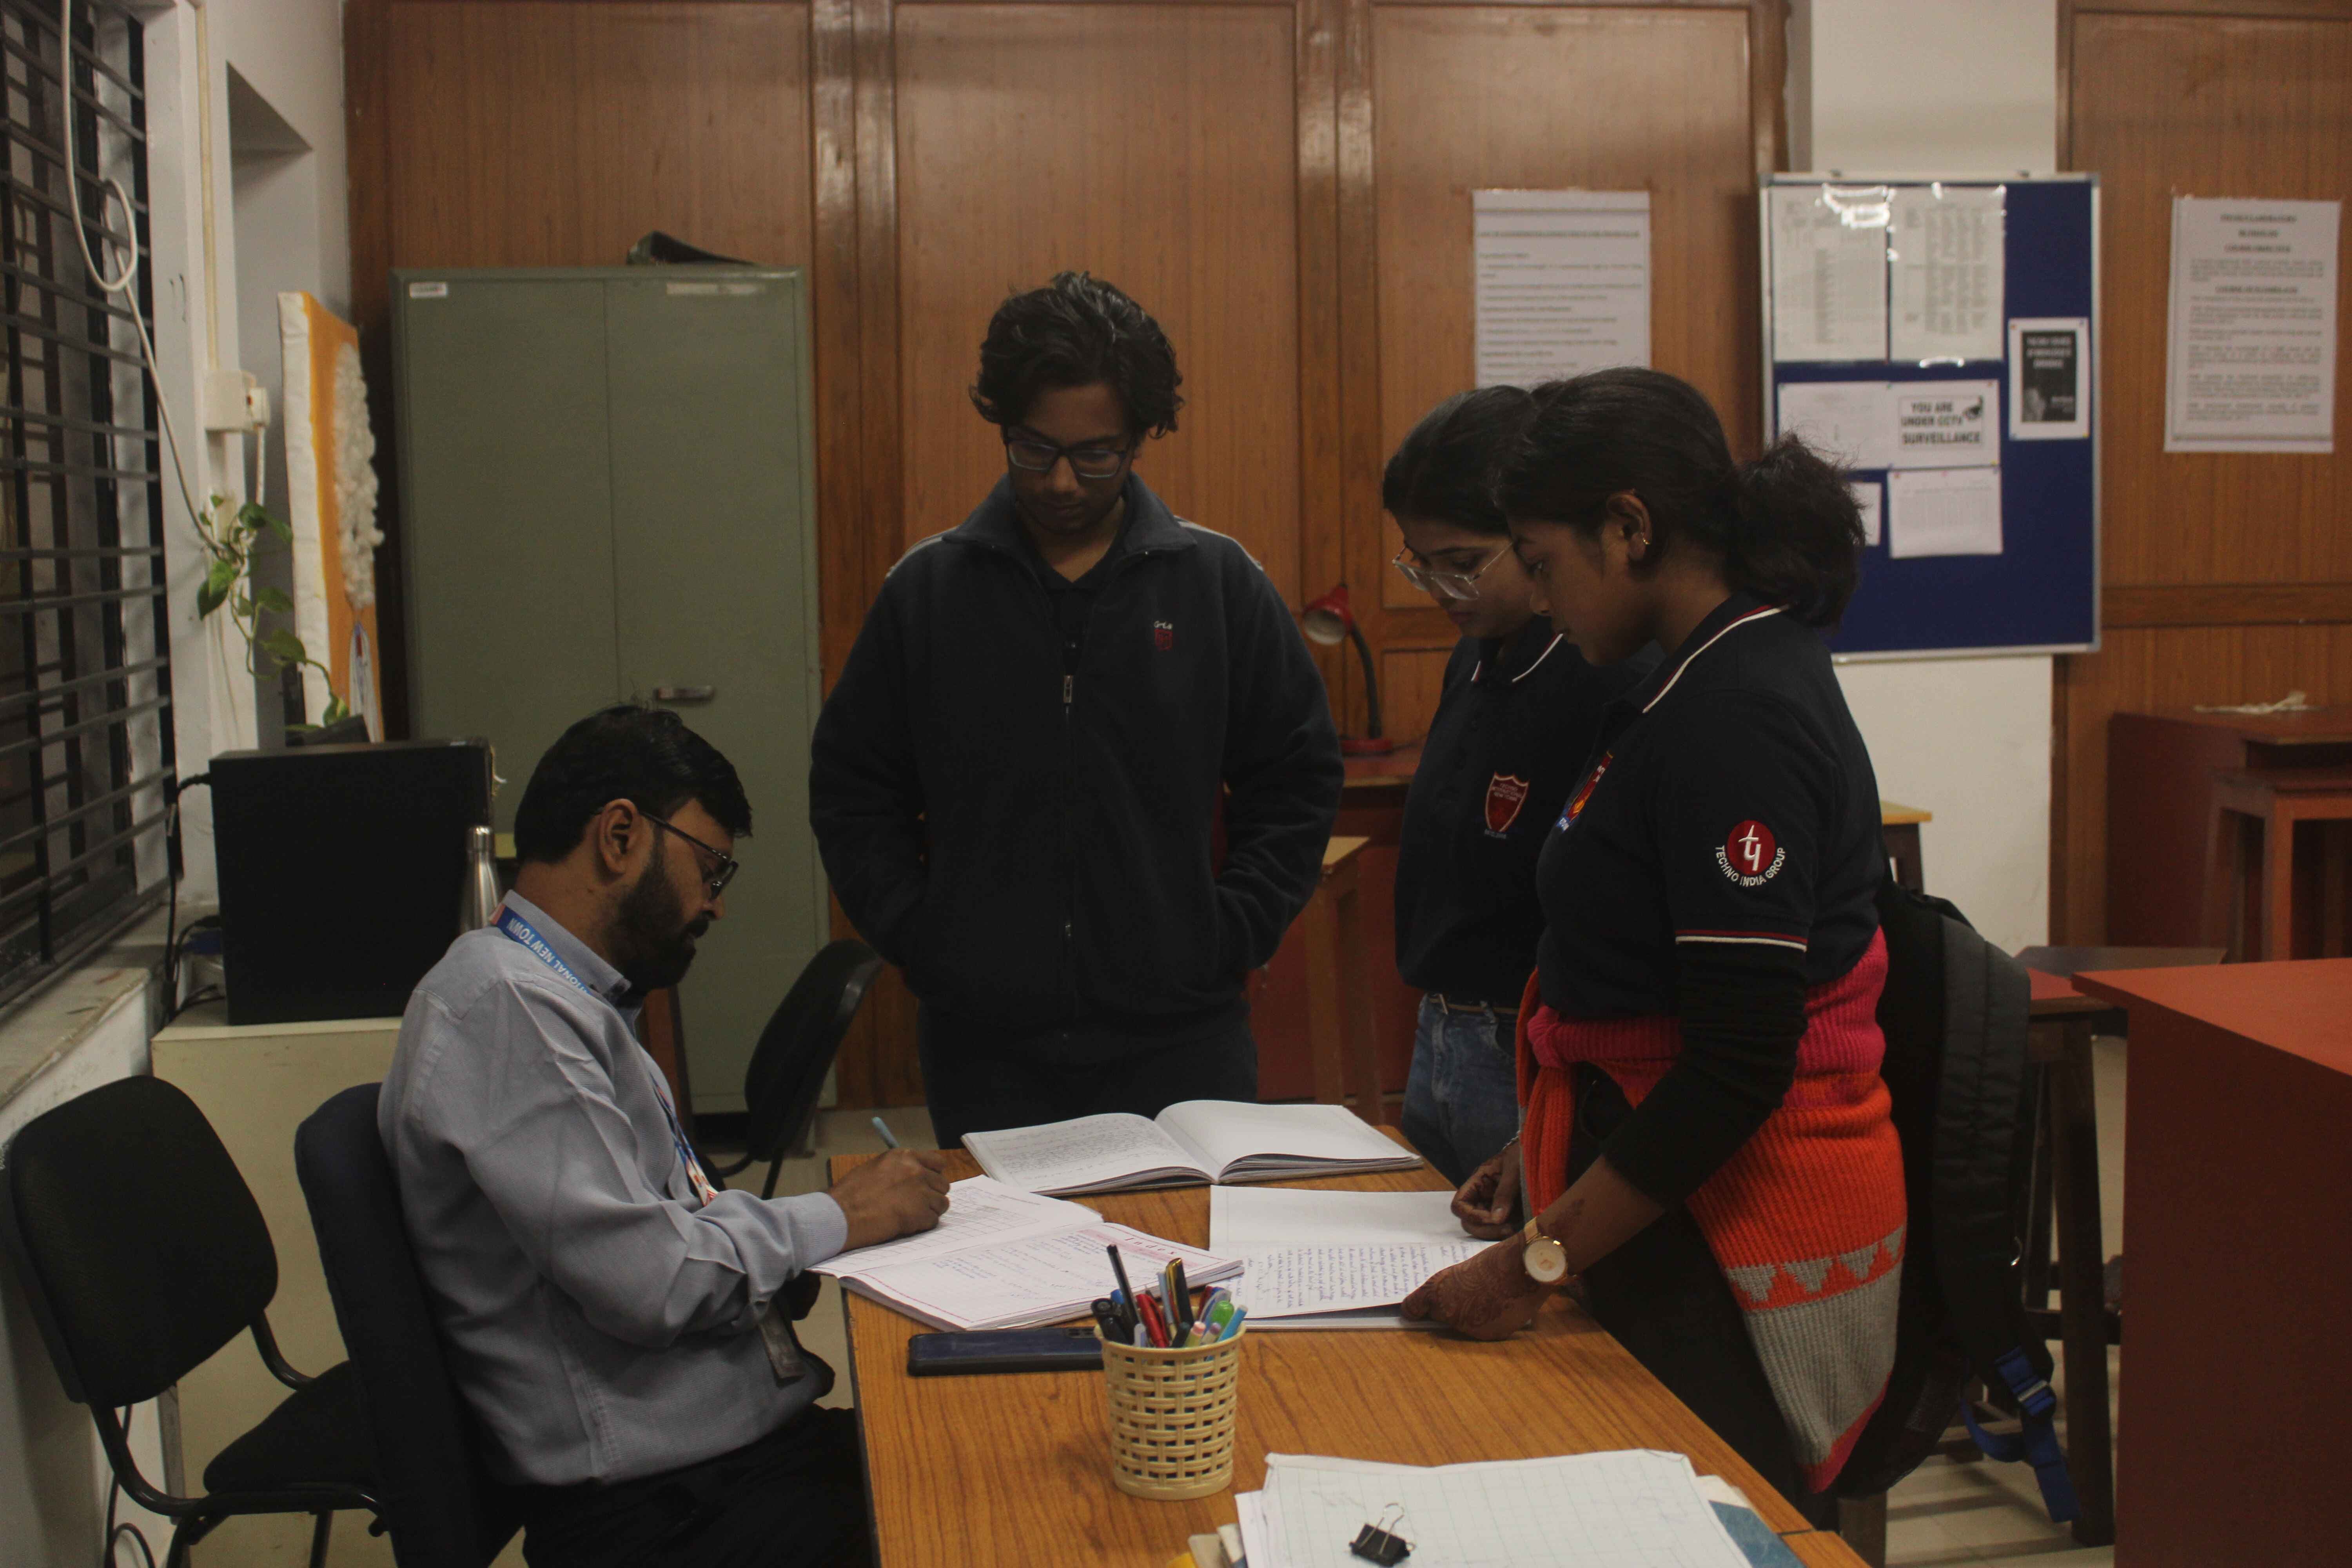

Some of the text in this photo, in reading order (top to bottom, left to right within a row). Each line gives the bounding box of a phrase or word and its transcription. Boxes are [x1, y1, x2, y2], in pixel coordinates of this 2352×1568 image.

[1911, 401, 1953, 413] YOU ARE
[1901, 415, 1963, 426] UNDER CCTV
[1902, 432, 1981, 445] SURVEILLANCE
[1715, 845, 1786, 887] TECHNO INDIA GROUP
[506, 918, 535, 946] TOWN
[530, 942, 555, 963] NEW
[1125, 1238, 1176, 1254] Index
